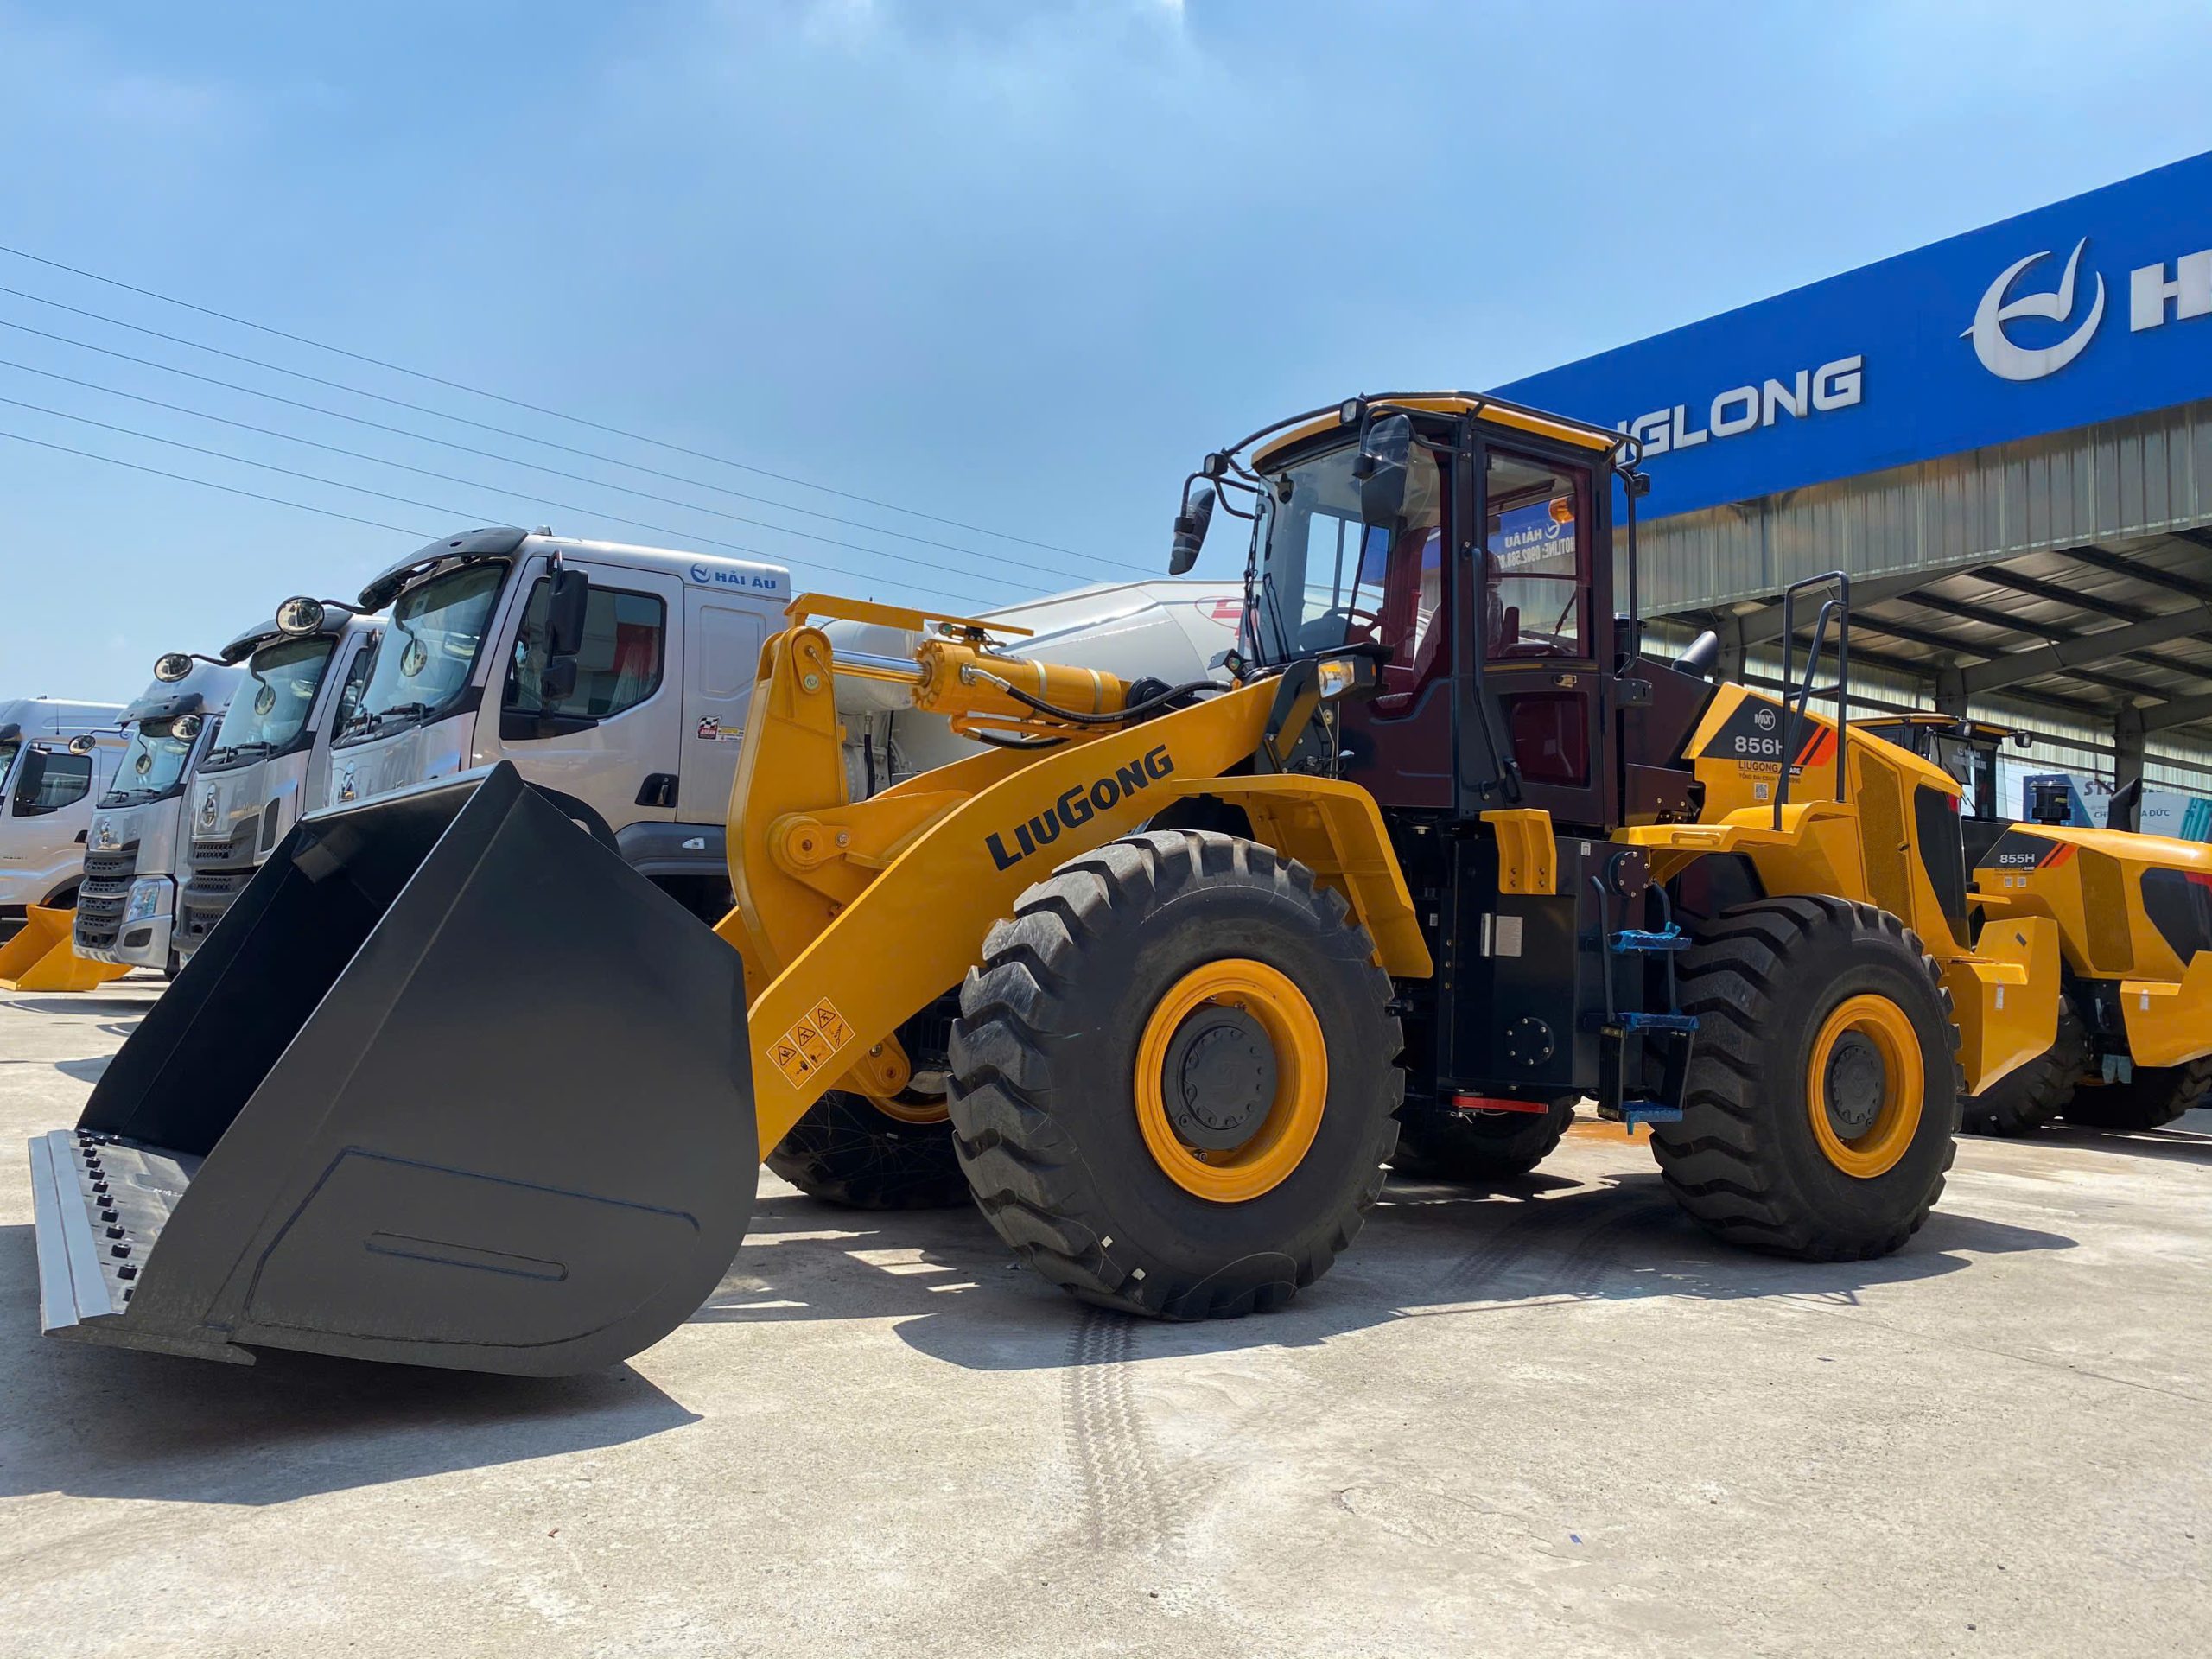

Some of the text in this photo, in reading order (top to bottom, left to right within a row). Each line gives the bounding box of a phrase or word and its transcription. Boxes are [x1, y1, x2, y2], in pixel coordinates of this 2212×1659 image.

[715, 570, 776, 589] HẢI ÂU
[1738, 760, 1778, 772] LIUGONG
[1999, 853, 2036, 864] 855H
